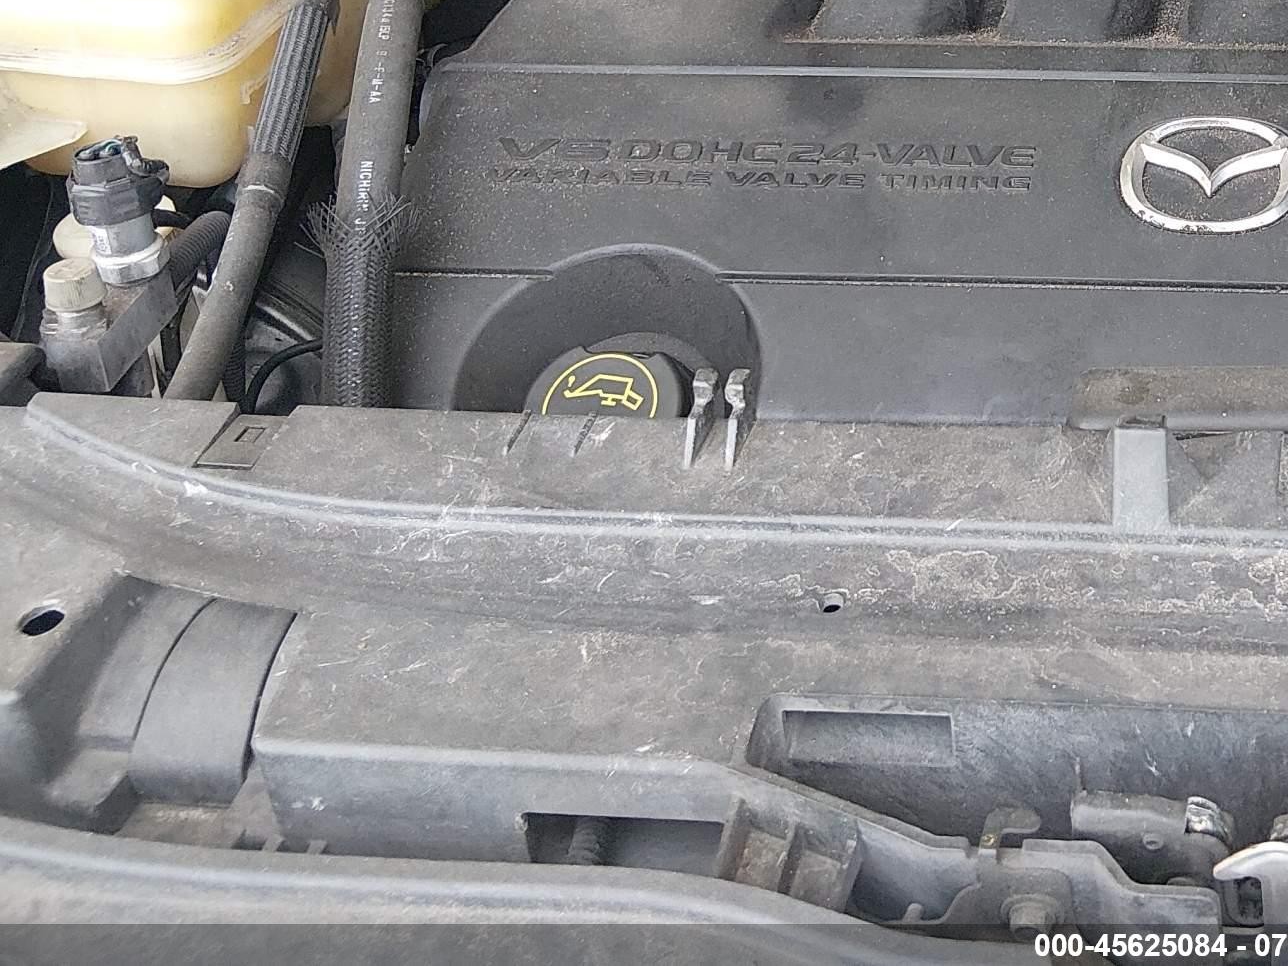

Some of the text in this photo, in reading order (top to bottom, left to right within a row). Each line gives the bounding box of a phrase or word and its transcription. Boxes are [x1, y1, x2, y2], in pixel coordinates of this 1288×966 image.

[618, 138, 783, 165] DOHC
[785, 142, 1038, 169] 24-VALVE
[356, 161, 373, 211] NICHIRIN
[489, 167, 1033, 193] VARIABLE VALVE TIMING
